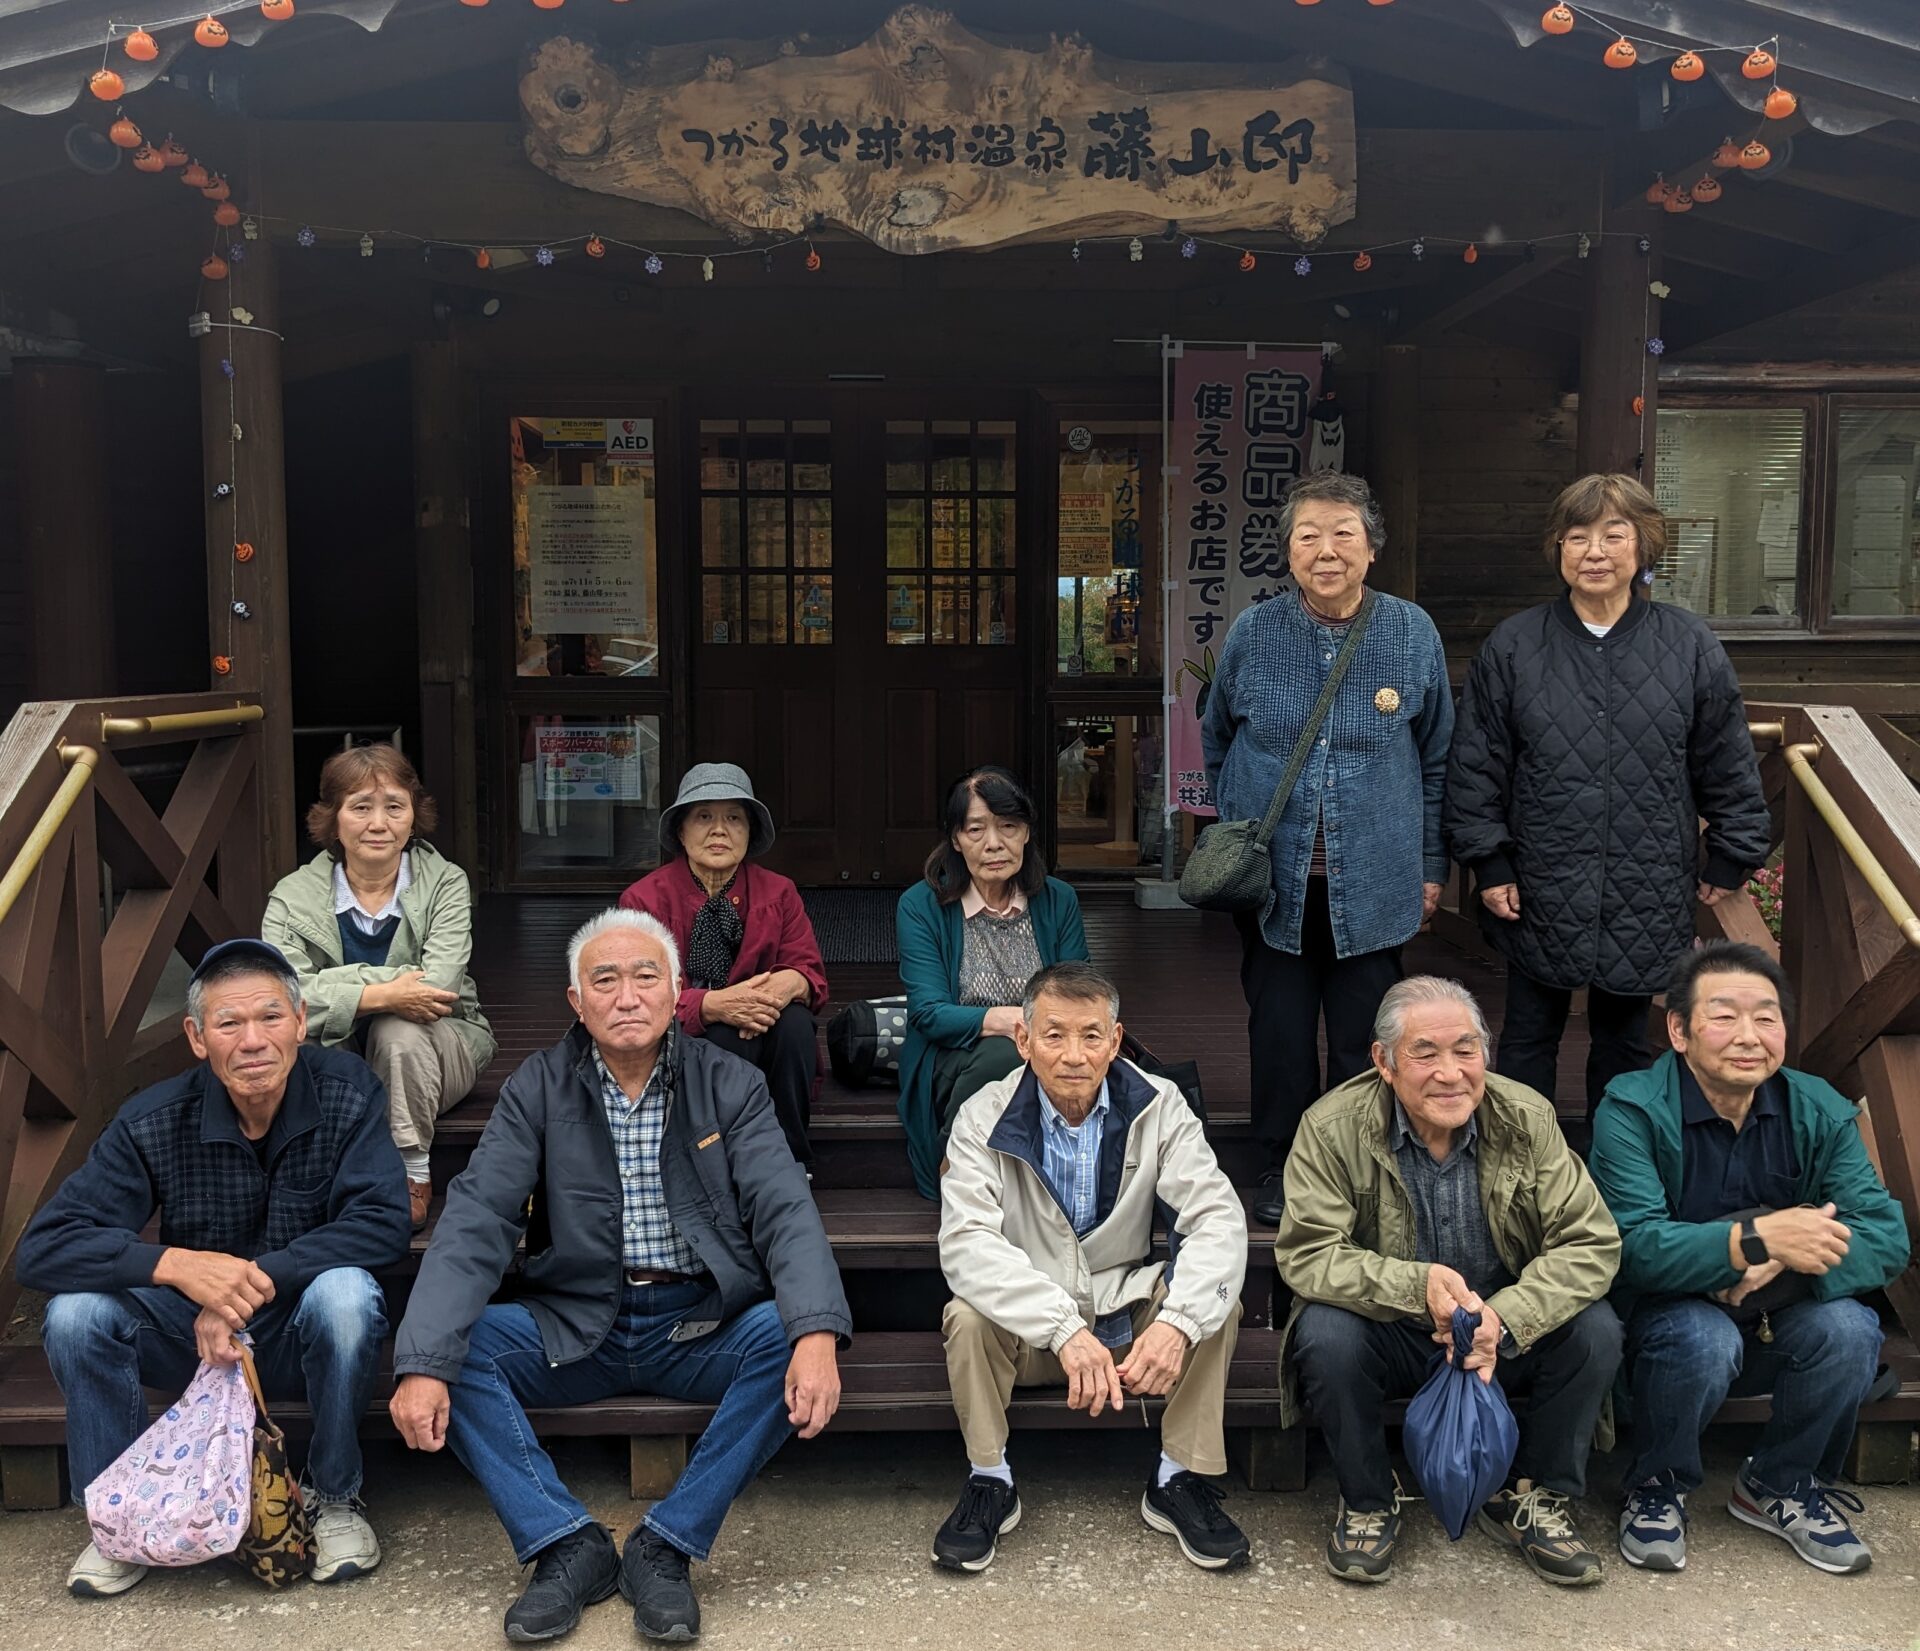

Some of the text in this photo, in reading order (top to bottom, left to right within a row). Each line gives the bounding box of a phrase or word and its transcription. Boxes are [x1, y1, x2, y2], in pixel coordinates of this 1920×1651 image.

[611, 436, 649, 449] AED
[1187, 382, 1234, 645] 使えるお店です
[1178, 771, 1207, 782] つがる
[1765, 1500, 1800, 1529] N
